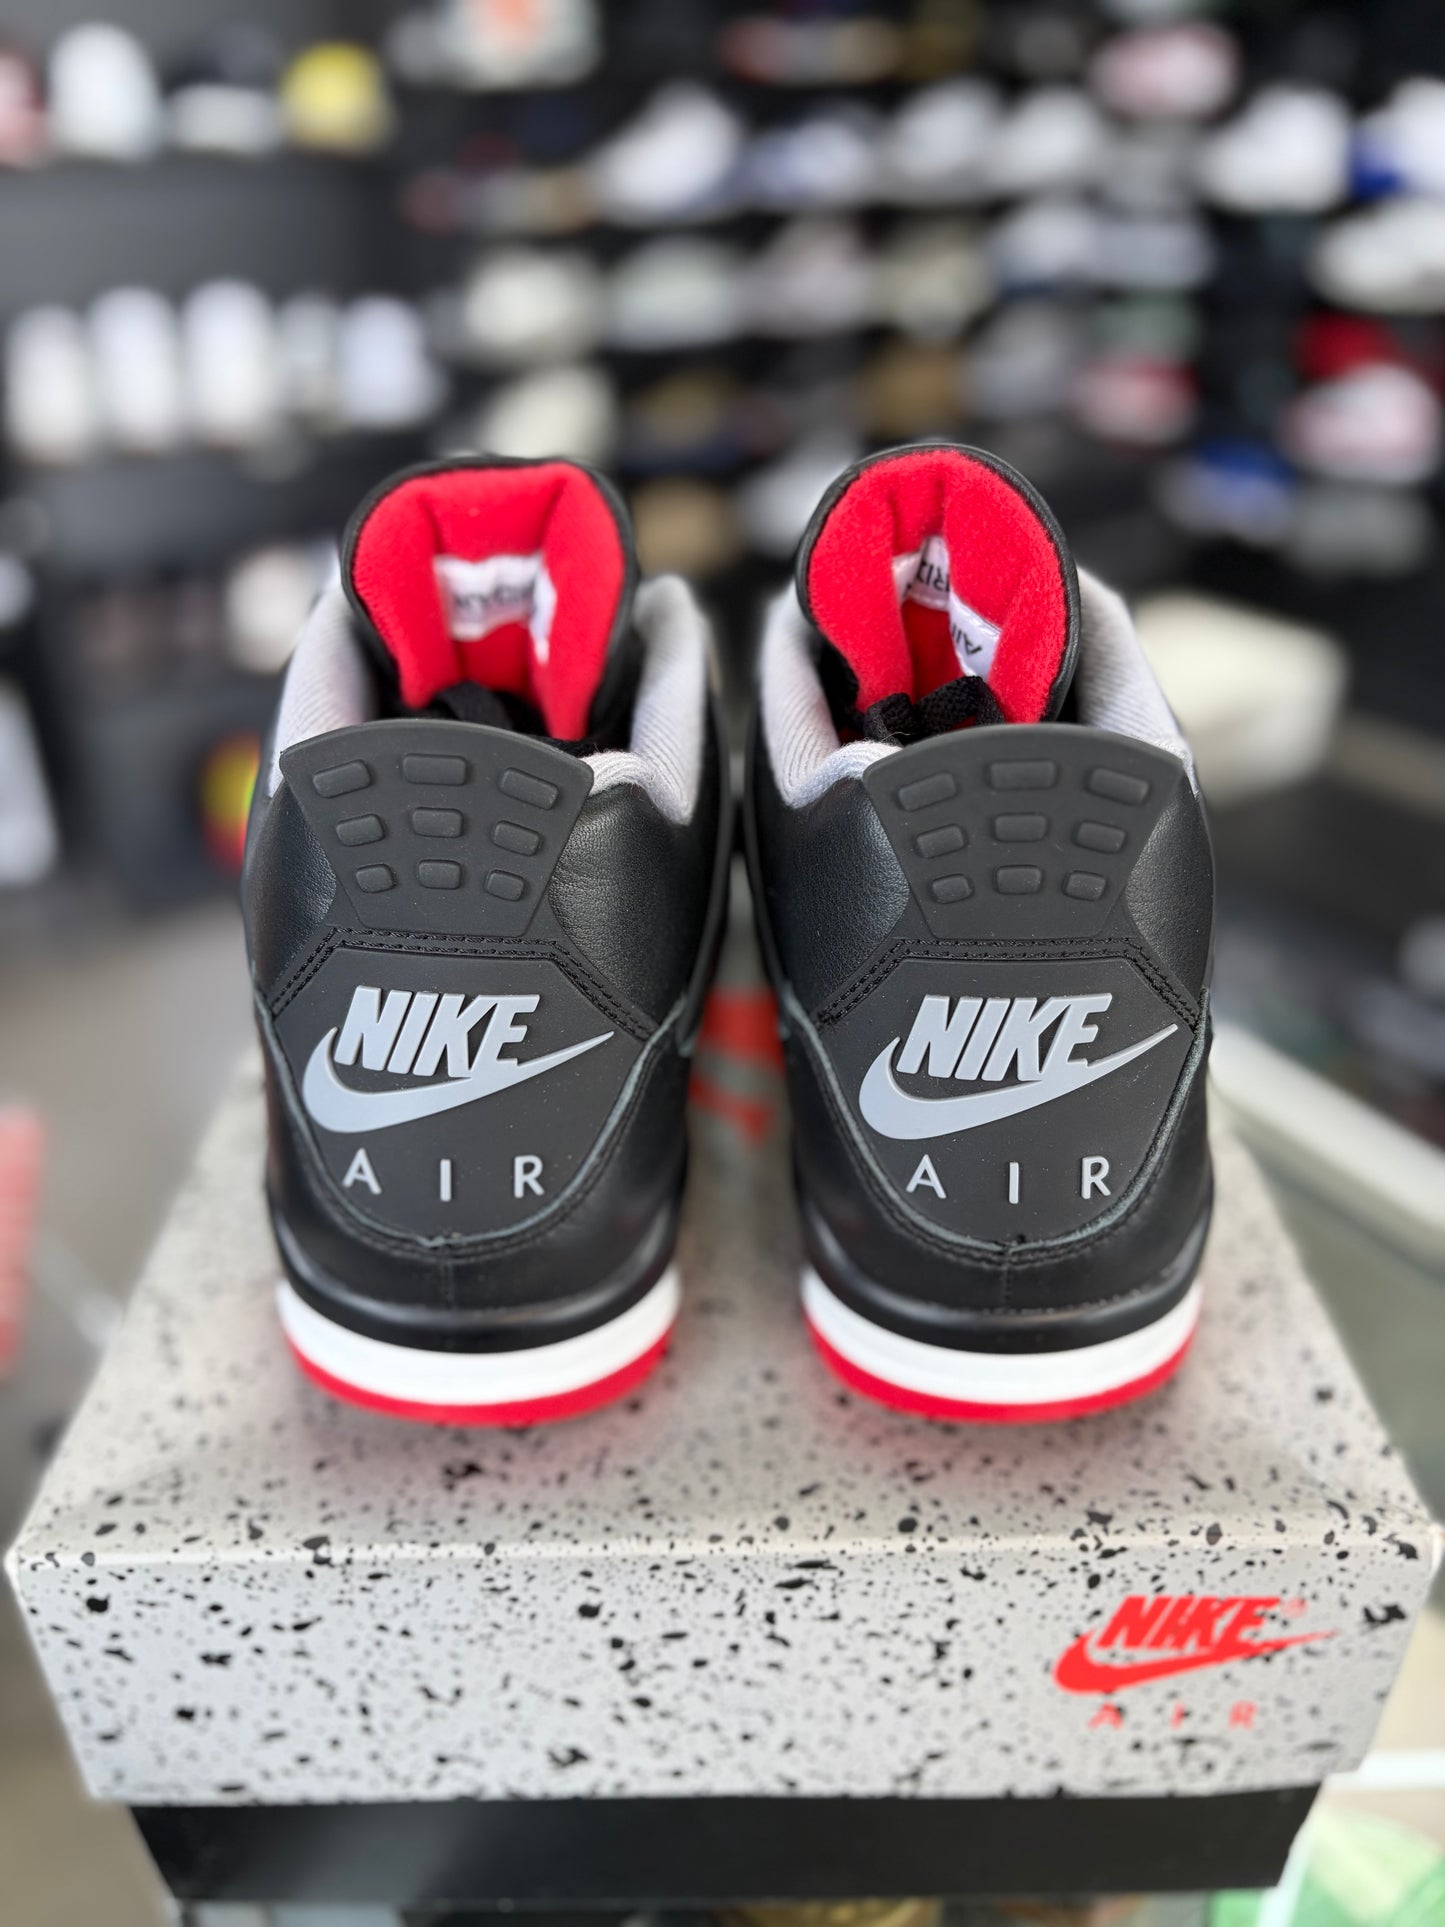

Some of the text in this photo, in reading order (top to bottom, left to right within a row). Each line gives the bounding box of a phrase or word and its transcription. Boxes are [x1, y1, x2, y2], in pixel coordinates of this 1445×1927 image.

[334, 985, 540, 1077] NIKE
[896, 993, 1113, 1081] NIKE
[342, 1147, 545, 1202] AIR
[905, 1154, 1111, 1204] AIR
[1096, 1595, 1280, 1650] NIKE
[1088, 1700, 1257, 1730] AIR
